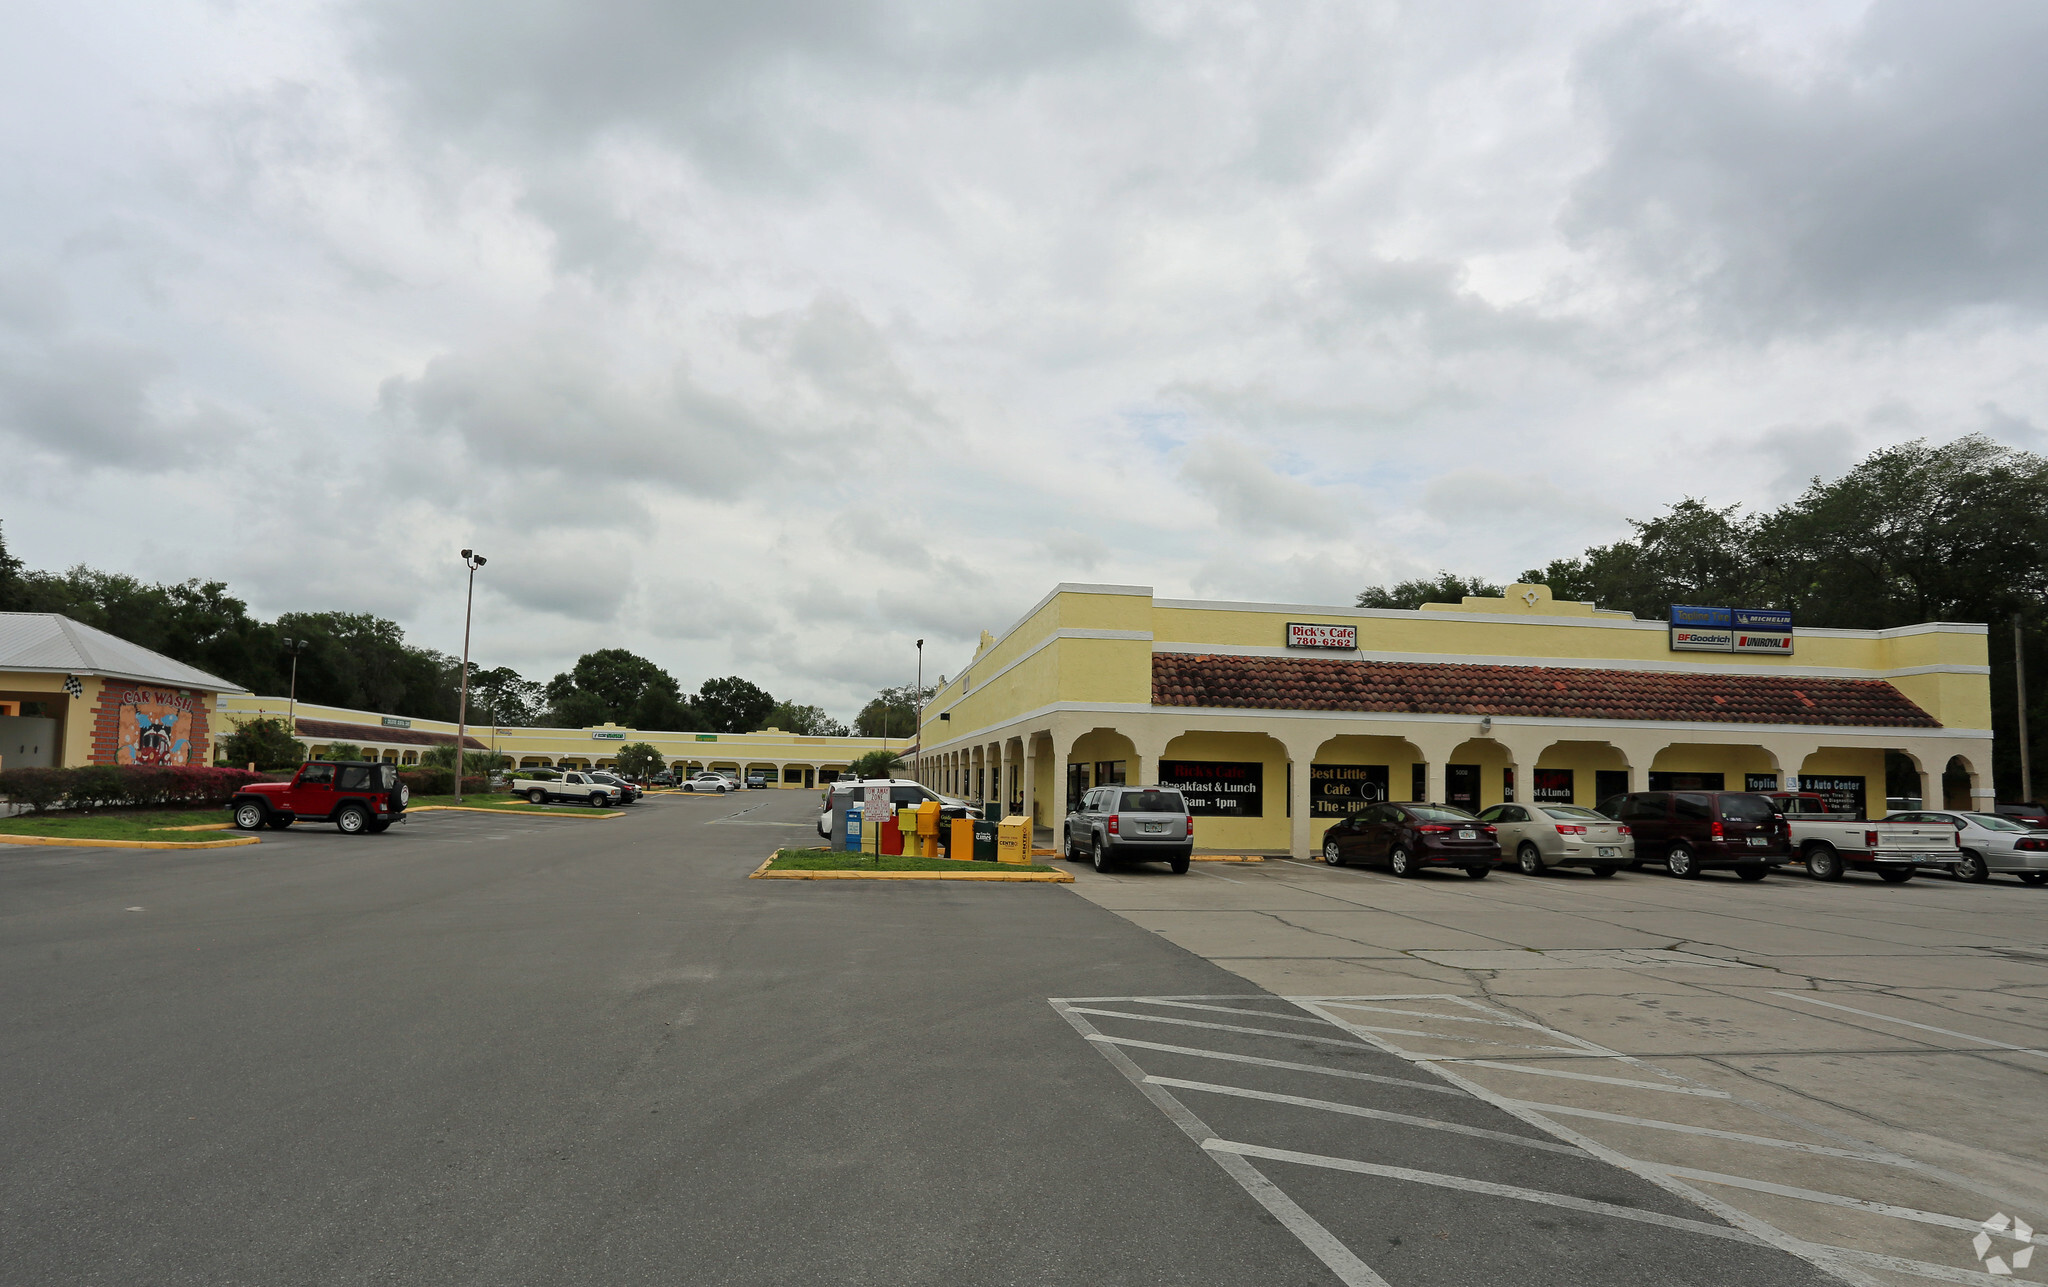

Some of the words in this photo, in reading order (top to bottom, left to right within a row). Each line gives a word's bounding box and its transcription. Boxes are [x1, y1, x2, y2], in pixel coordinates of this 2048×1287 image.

[1293, 626, 1326, 637] Rick's
[1330, 628, 1354, 638] Cafe
[1297, 638, 1350, 646] 780-6262
[1678, 634, 1730, 643] BFGoodrich
[1747, 637, 1782, 648] UNIROYAL
[122, 690, 151, 704] CAR
[154, 692, 193, 711] WASH
[1174, 764, 1213, 777] Rick's
[1216, 766, 1246, 778] Cafe
[1310, 768, 1334, 779] Best
[1336, 768, 1366, 780] Little
[1214, 782, 1222, 792] &
[1224, 782, 1256, 792] Lunch
[1324, 784, 1350, 795] Cafe
[1806, 780, 1812, 790] &
[1814, 780, 1832, 790] Auto
[1834, 780, 1860, 790] Center
[1548, 788, 1570, 796] Lunch
[1184, 796, 1206, 806] 6am
[1215, 798, 1237, 808] 1pm
[1317, 801, 1338, 812] The
